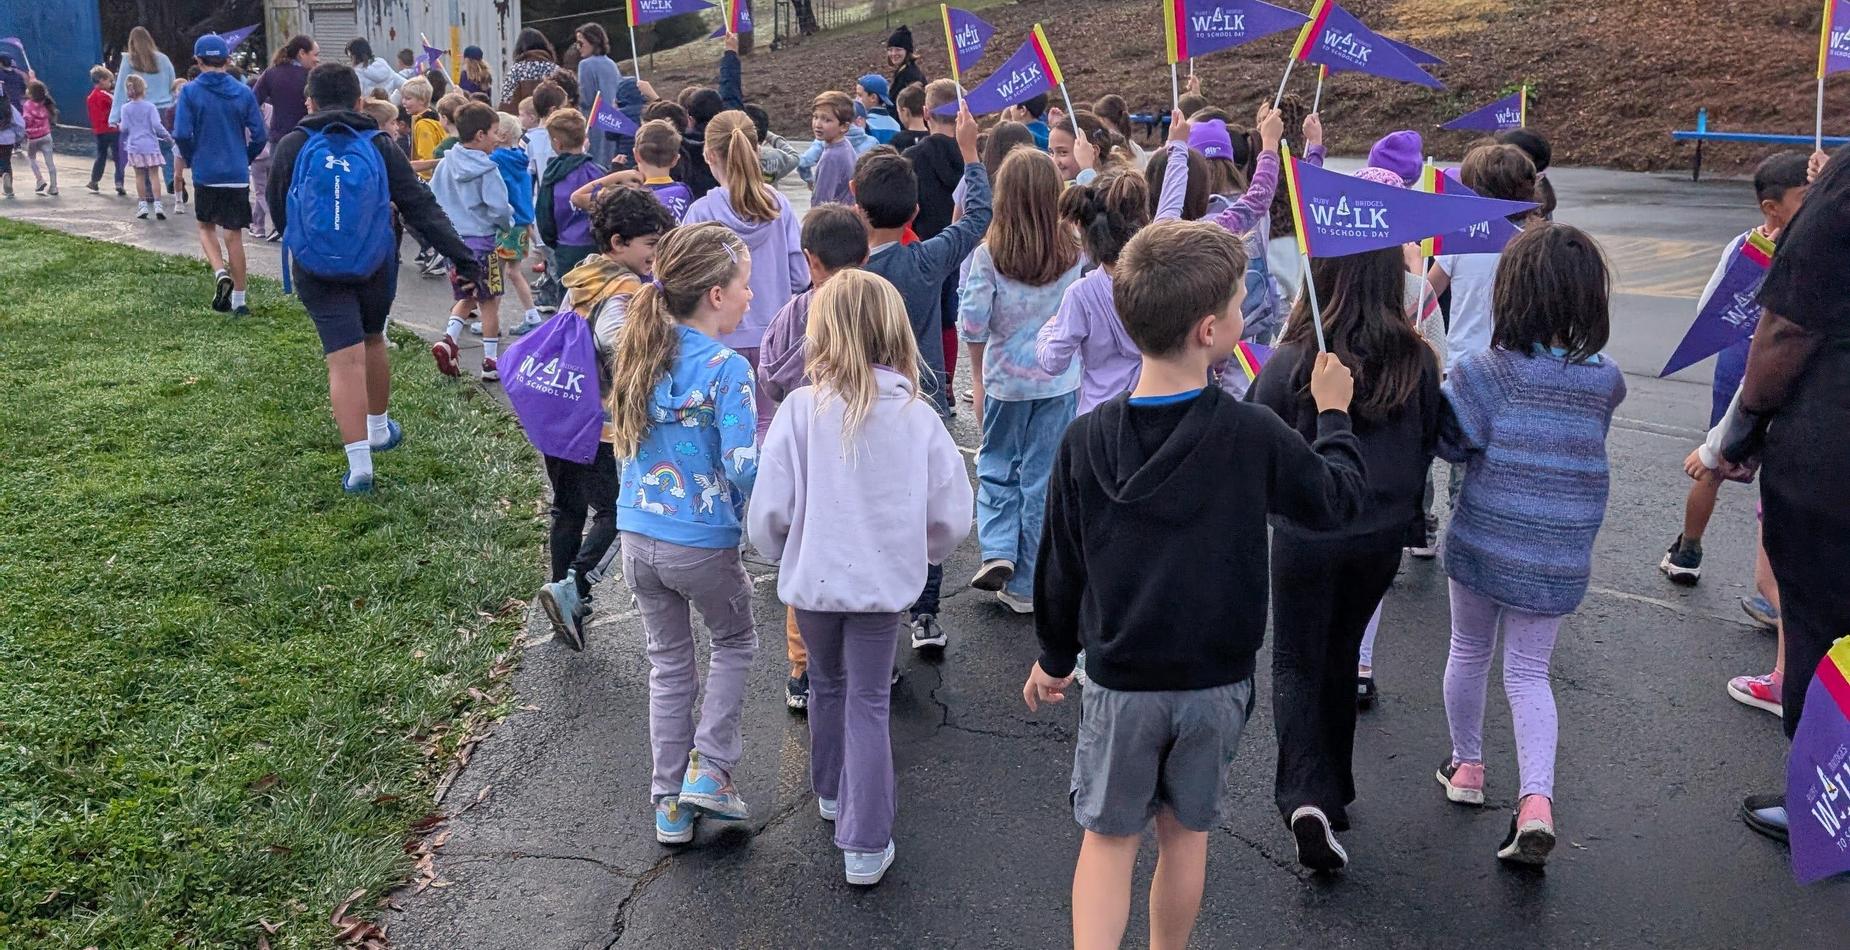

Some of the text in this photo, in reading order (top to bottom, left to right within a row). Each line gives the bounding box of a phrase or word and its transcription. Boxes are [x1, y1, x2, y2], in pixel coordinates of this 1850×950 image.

[1192, 6, 1245, 31] WALK
[1324, 30, 1372, 62] WALK
[997, 63, 1041, 98] WALK
[598, 112, 623, 128] WALK
[1495, 107, 1521, 123] WALK
[1309, 195, 1390, 229] WALK
[1317, 226, 1327, 234] TO
[1330, 228, 1368, 237] SCHOOL
[519, 354, 585, 393] WALK
[516, 373, 582, 402] TO SCHOOL DAY
[1837, 836, 1848, 852] TO
